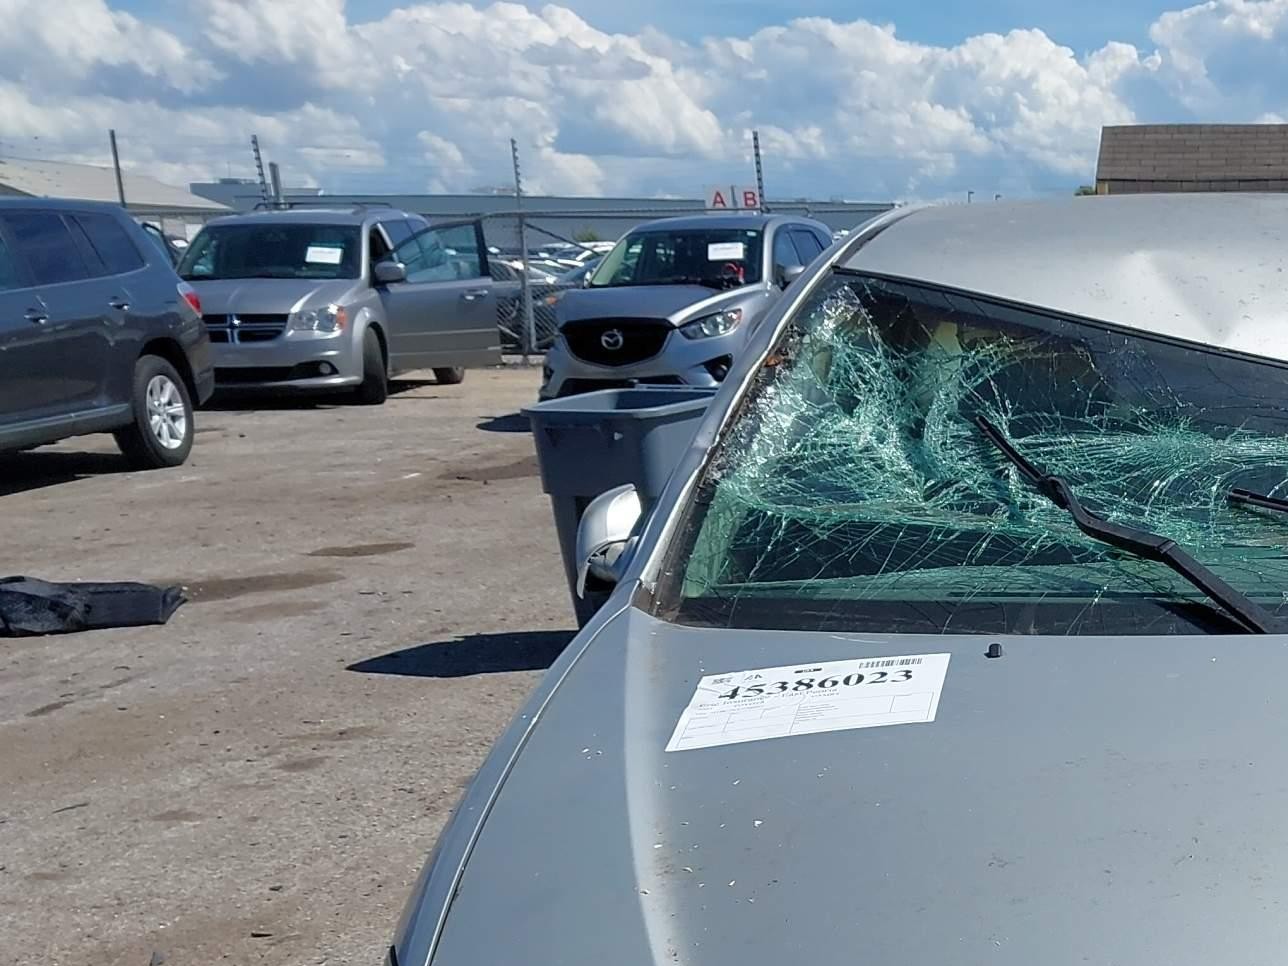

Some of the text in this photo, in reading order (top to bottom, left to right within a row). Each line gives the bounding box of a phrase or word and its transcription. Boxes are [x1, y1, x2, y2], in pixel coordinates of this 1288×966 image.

[713, 191, 726, 207] A
[743, 191, 757, 207] B
[718, 669, 913, 700] 45386023
